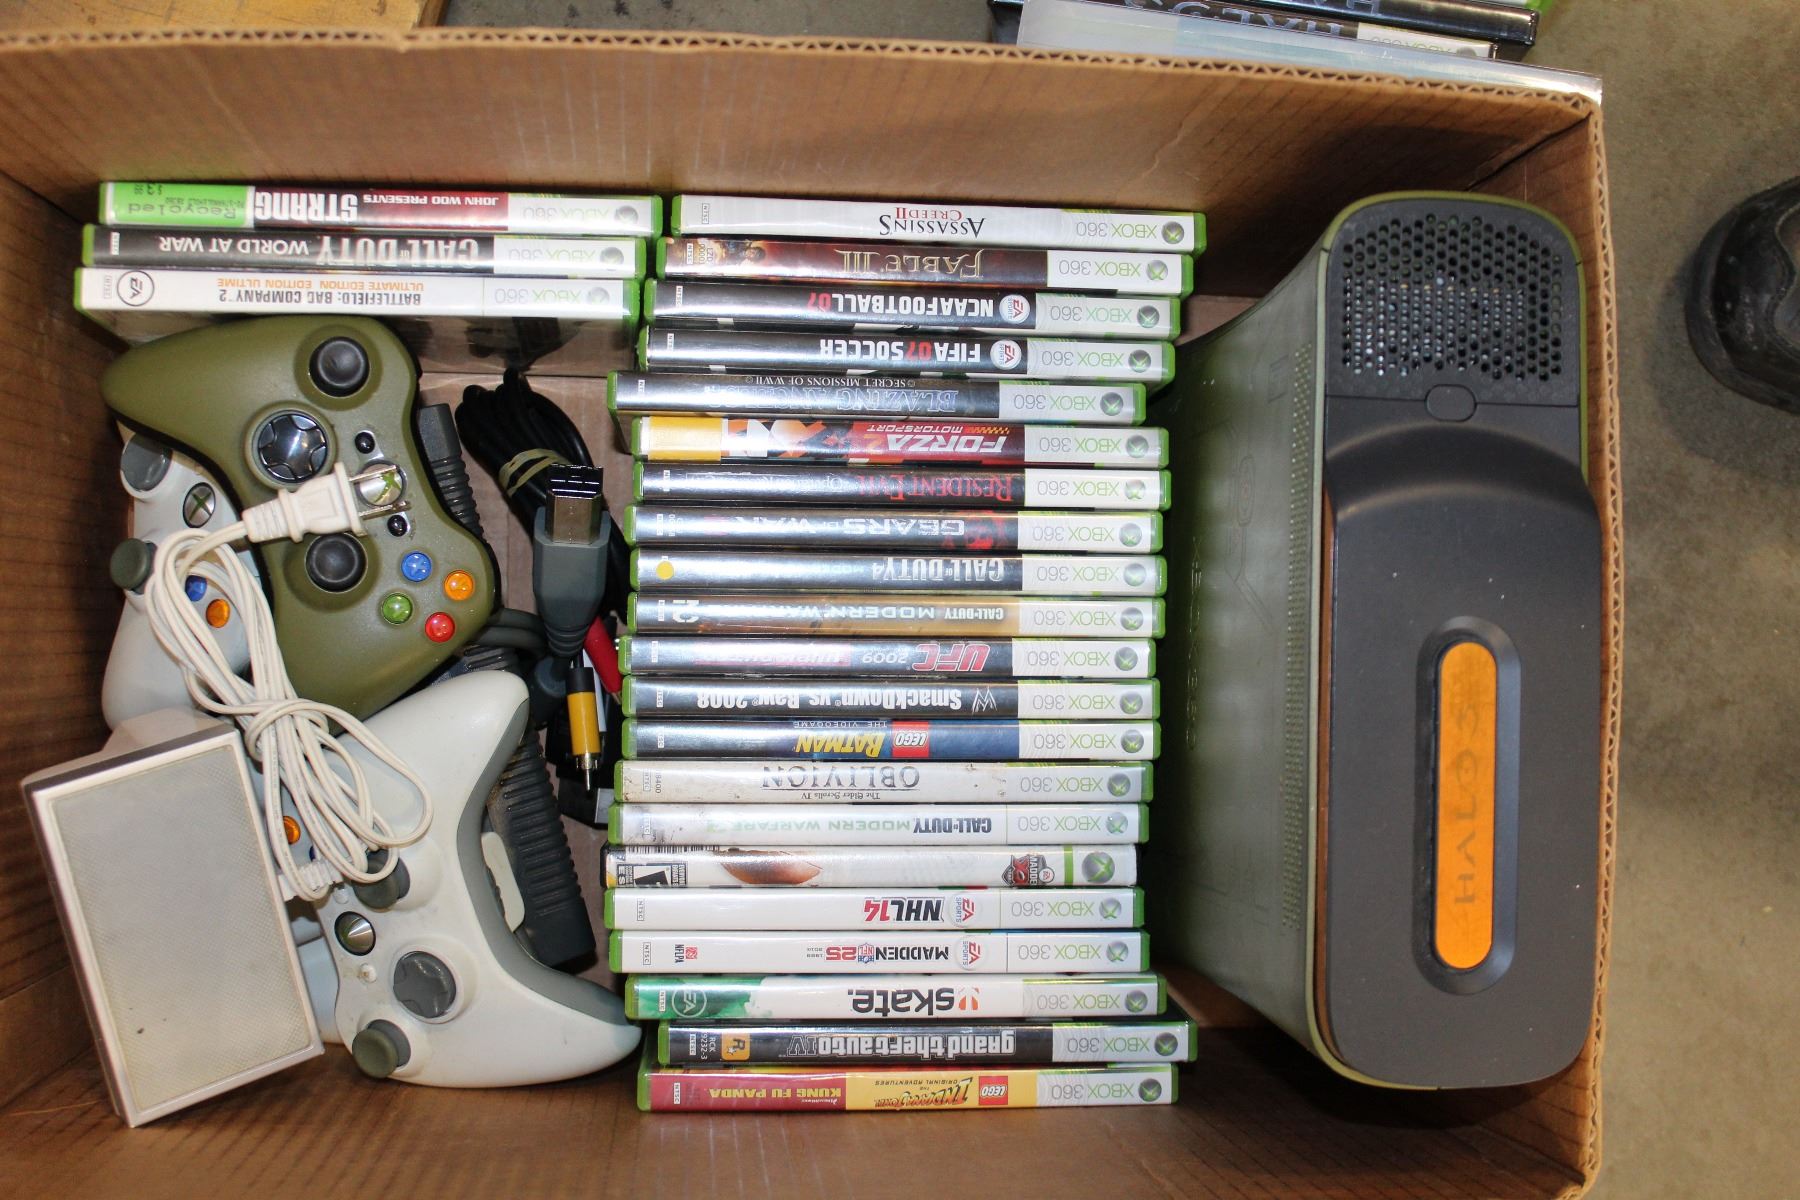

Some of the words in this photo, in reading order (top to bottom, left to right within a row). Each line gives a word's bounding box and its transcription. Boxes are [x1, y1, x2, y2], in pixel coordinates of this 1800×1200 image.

[362, 194, 428, 205] PRESENTS
[431, 195, 462, 206] WOO
[464, 196, 500, 206] JOHN
[127, 203, 237, 219] Recycled
[908, 210, 963, 221] CREED
[1075, 222, 1108, 237] 360
[1111, 224, 1158, 239] XBOX
[159, 236, 205, 253] WAR
[208, 238, 233, 253] AT
[237, 238, 310, 256] WORLD
[316, 235, 398, 267] DUTY
[406, 239, 480, 269] CALL
[834, 249, 881, 275] III
[883, 249, 984, 279] FABLE
[1059, 260, 1091, 275] 360
[1094, 262, 1141, 277] XBOX
[218, 278, 261, 289] ULTIME
[265, 279, 312, 290] EDITION
[320, 280, 365, 291] EDITION
[368, 281, 425, 292] ULTIMATE
[337, 291, 421, 306] BATTLEFIELD:
[494, 288, 529, 303] 360
[533, 288, 581, 303] XBOX
[1051, 305, 1083, 320] 360
[1086, 306, 1132, 321] XBOX
[820, 339, 904, 361] SOCCER
[904, 340, 933, 361] 07
[934, 342, 981, 363] FIFA
[1041, 351, 1074, 366] 360
[1077, 352, 1124, 367] XBOX
[756, 376, 785, 386] WWII
[788, 377, 804, 386] OF
[807, 377, 861, 388] MISSIONS
[862, 379, 906, 389] SECRET
[836, 388, 959, 413] BLAZING
[1013, 395, 1046, 410] 360
[1049, 396, 1096, 411] XBOX
[867, 424, 964, 434] MOTORSPORT
[887, 433, 1008, 453] FORZA
[1039, 437, 1071, 452] 360
[1074, 437, 1121, 452] XBOX
[853, 474, 907, 501] EVIL
[909, 474, 1014, 502] RESIDENT
[1038, 481, 1069, 496] 360
[1073, 482, 1119, 497] XBOX
[844, 518, 965, 535] GEARS
[1033, 526, 1065, 541] 360
[1068, 527, 1115, 541] XBOX
[884, 557, 944, 581] DUTY
[951, 559, 1005, 582] CALL
[1037, 567, 1069, 582] 360
[1073, 567, 1120, 582] XBOX
[832, 606, 936, 618] MODERN
[943, 606, 974, 619] DUTY
[976, 607, 1004, 619] CALL
[1034, 611, 1066, 626] 360
[1069, 611, 1116, 626] XBOX
[863, 651, 911, 664] 2009
[912, 643, 991, 672] UFC
[1028, 651, 1060, 666] 360
[1063, 651, 1110, 666] XBOX
[697, 690, 749, 709] 2008
[1033, 694, 1065, 709] 360
[1068, 695, 1115, 710] XBOX
[794, 732, 888, 758] BATMAN
[892, 732, 928, 747] LEGO
[1034, 734, 1066, 749] 360
[1069, 734, 1117, 749] XBOX
[761, 765, 920, 789] OBLIVION
[1021, 777, 1053, 792] 360
[1057, 777, 1104, 792] XBOX
[800, 792, 812, 800] IV
[814, 792, 841, 800] Scrolls
[842, 792, 863, 801] Elder
[864, 792, 880, 800] The
[829, 820, 911, 831] MODERN
[913, 818, 953, 834] DUTY
[957, 818, 992, 834] CALL
[1019, 816, 1051, 831] 360
[1054, 816, 1101, 831] XBOX
[1452, 746, 1477, 906] HALO
[961, 897, 975, 922] EA
[1012, 902, 1044, 917] 360
[1047, 902, 1094, 917] XBOX
[643, 943, 651, 965] NTSC
[675, 944, 684, 963] NFLPA
[825, 946, 857, 961] 25
[875, 946, 950, 961] MADDEN
[968, 942, 980, 966] EA
[1019, 945, 1051, 960] 360
[1054, 945, 1101, 960] XBOX
[682, 991, 697, 1013] EA
[847, 988, 955, 1018] skate.
[1037, 994, 1069, 1009] 360
[1073, 994, 1120, 1009] XBOX
[689, 1034, 697, 1056] NTSC
[1067, 1037, 1100, 1053] 360
[1103, 1037, 1151, 1053] XBOX
[709, 1088, 767, 1098] PANDA
[768, 1088, 792, 1098] FU
[796, 1088, 841, 1098] KUNG
[980, 1085, 1007, 1099] LEGO
[1052, 1085, 1084, 1100] 360
[1087, 1084, 1135, 1099] XBOX
